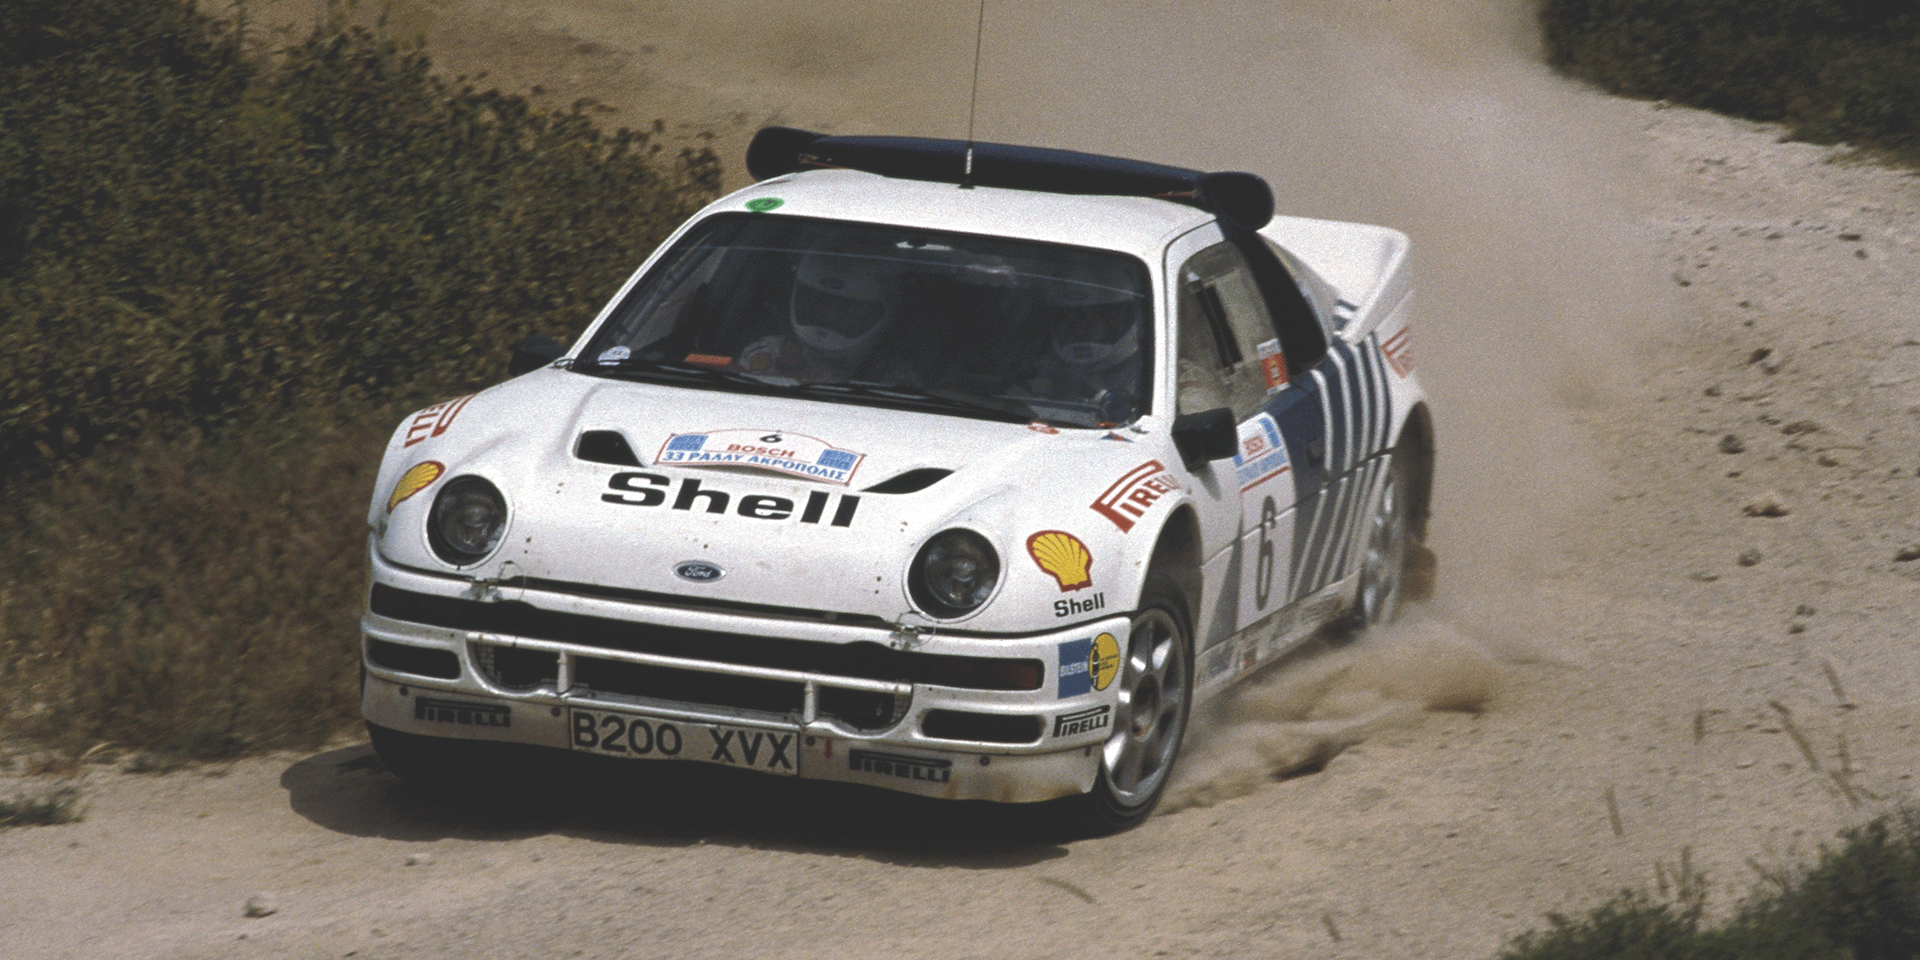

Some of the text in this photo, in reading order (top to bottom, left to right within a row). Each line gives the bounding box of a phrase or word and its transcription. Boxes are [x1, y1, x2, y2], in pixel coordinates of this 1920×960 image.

[726, 443, 795, 458] BOSCH
[760, 434, 782, 443] 6
[663, 451, 685, 461] 33
[600, 471, 861, 528] Shell
[1089, 459, 1180, 534] PIRELLI
[1256, 495, 1276, 611] 6
[1053, 592, 1106, 618] Shell
[414, 696, 512, 727] PIRELLI
[1052, 705, 1111, 738] PIRELLI
[572, 711, 793, 770] B200 XVX
[849, 749, 952, 783] PIRELLI
